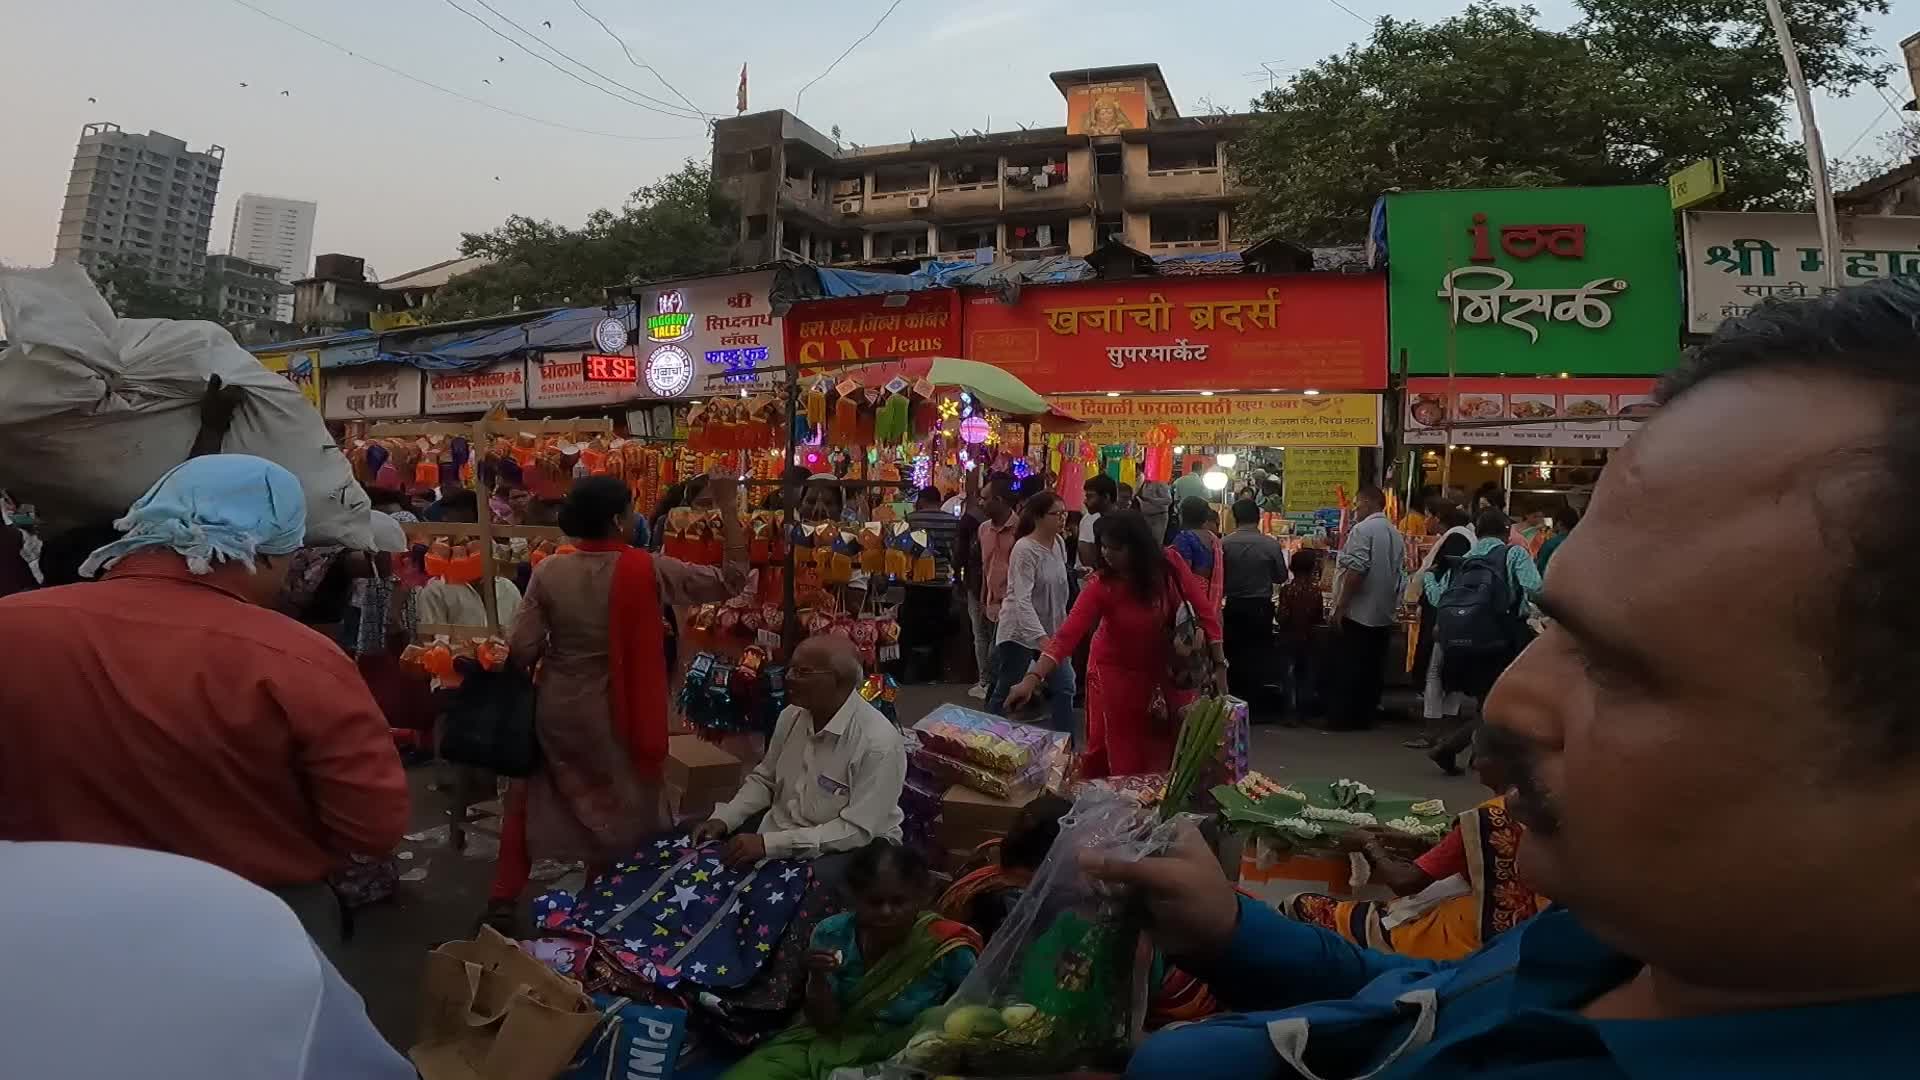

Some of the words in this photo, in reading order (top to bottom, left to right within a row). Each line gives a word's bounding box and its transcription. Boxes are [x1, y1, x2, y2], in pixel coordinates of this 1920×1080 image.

[1704, 238, 1780, 277] श्री
[727, 292, 753, 309] श्री
[1044, 293, 1176, 336] खजांची
[1184, 288, 1282, 333] ब्रदर्स
[647, 314, 690, 329] JAGGERY
[653, 325, 684, 338] TALES
[886, 334, 943, 353] Jeans
[1106, 338, 1209, 368] सुपरमार्केट
[1080, 398, 1133, 415] दिवाळी
[1137, 398, 1232, 415] फराळासाठी
